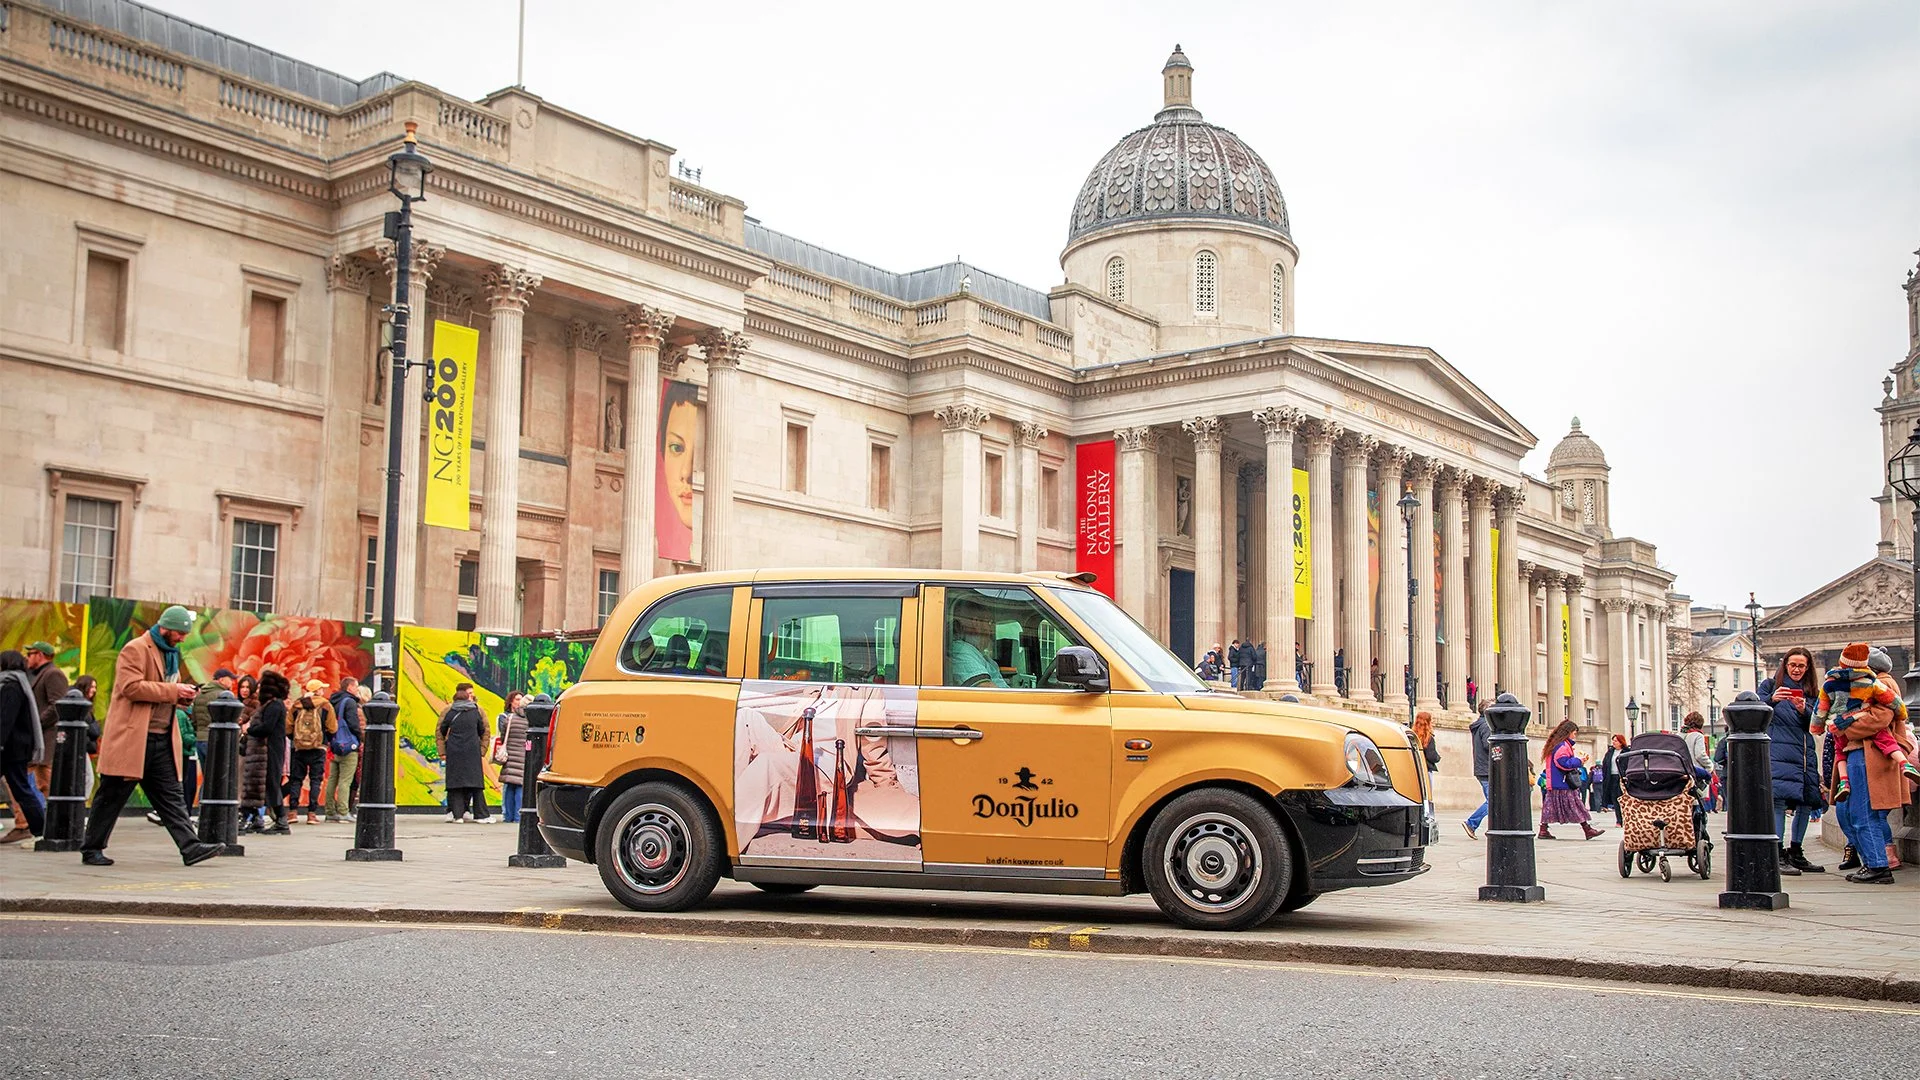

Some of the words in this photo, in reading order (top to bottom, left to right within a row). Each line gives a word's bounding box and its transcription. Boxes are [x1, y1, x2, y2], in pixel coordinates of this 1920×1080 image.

[433, 357, 459, 484] NG200
[457, 441, 463, 450] OF
[1087, 469, 1097, 555] NATIONAL
[1098, 469, 1111, 555] GALLERY
[593, 730, 630, 742] BAFTA
